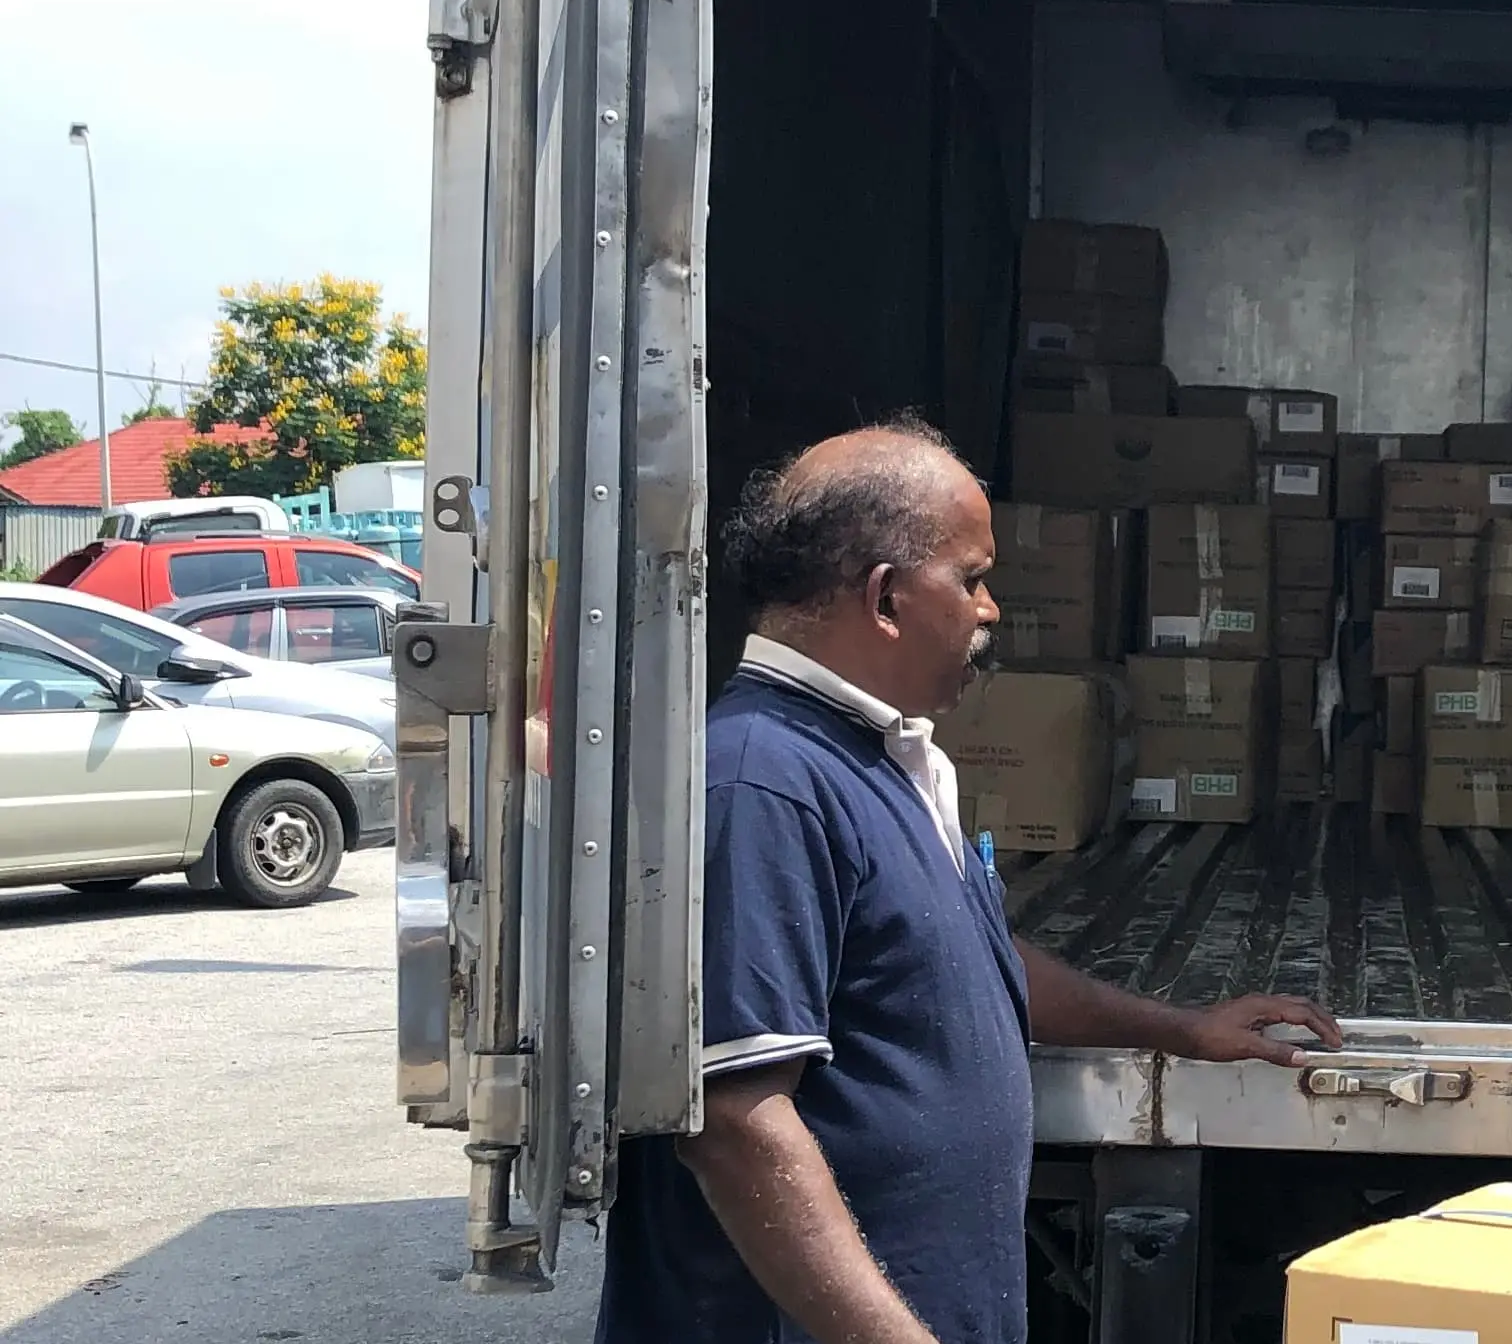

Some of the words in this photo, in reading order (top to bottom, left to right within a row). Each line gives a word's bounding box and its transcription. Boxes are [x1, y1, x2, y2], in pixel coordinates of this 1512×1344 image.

[1214, 613, 1252, 630] PHB
[1437, 694, 1478, 710] PHB
[1194, 776, 1233, 793] PHB
